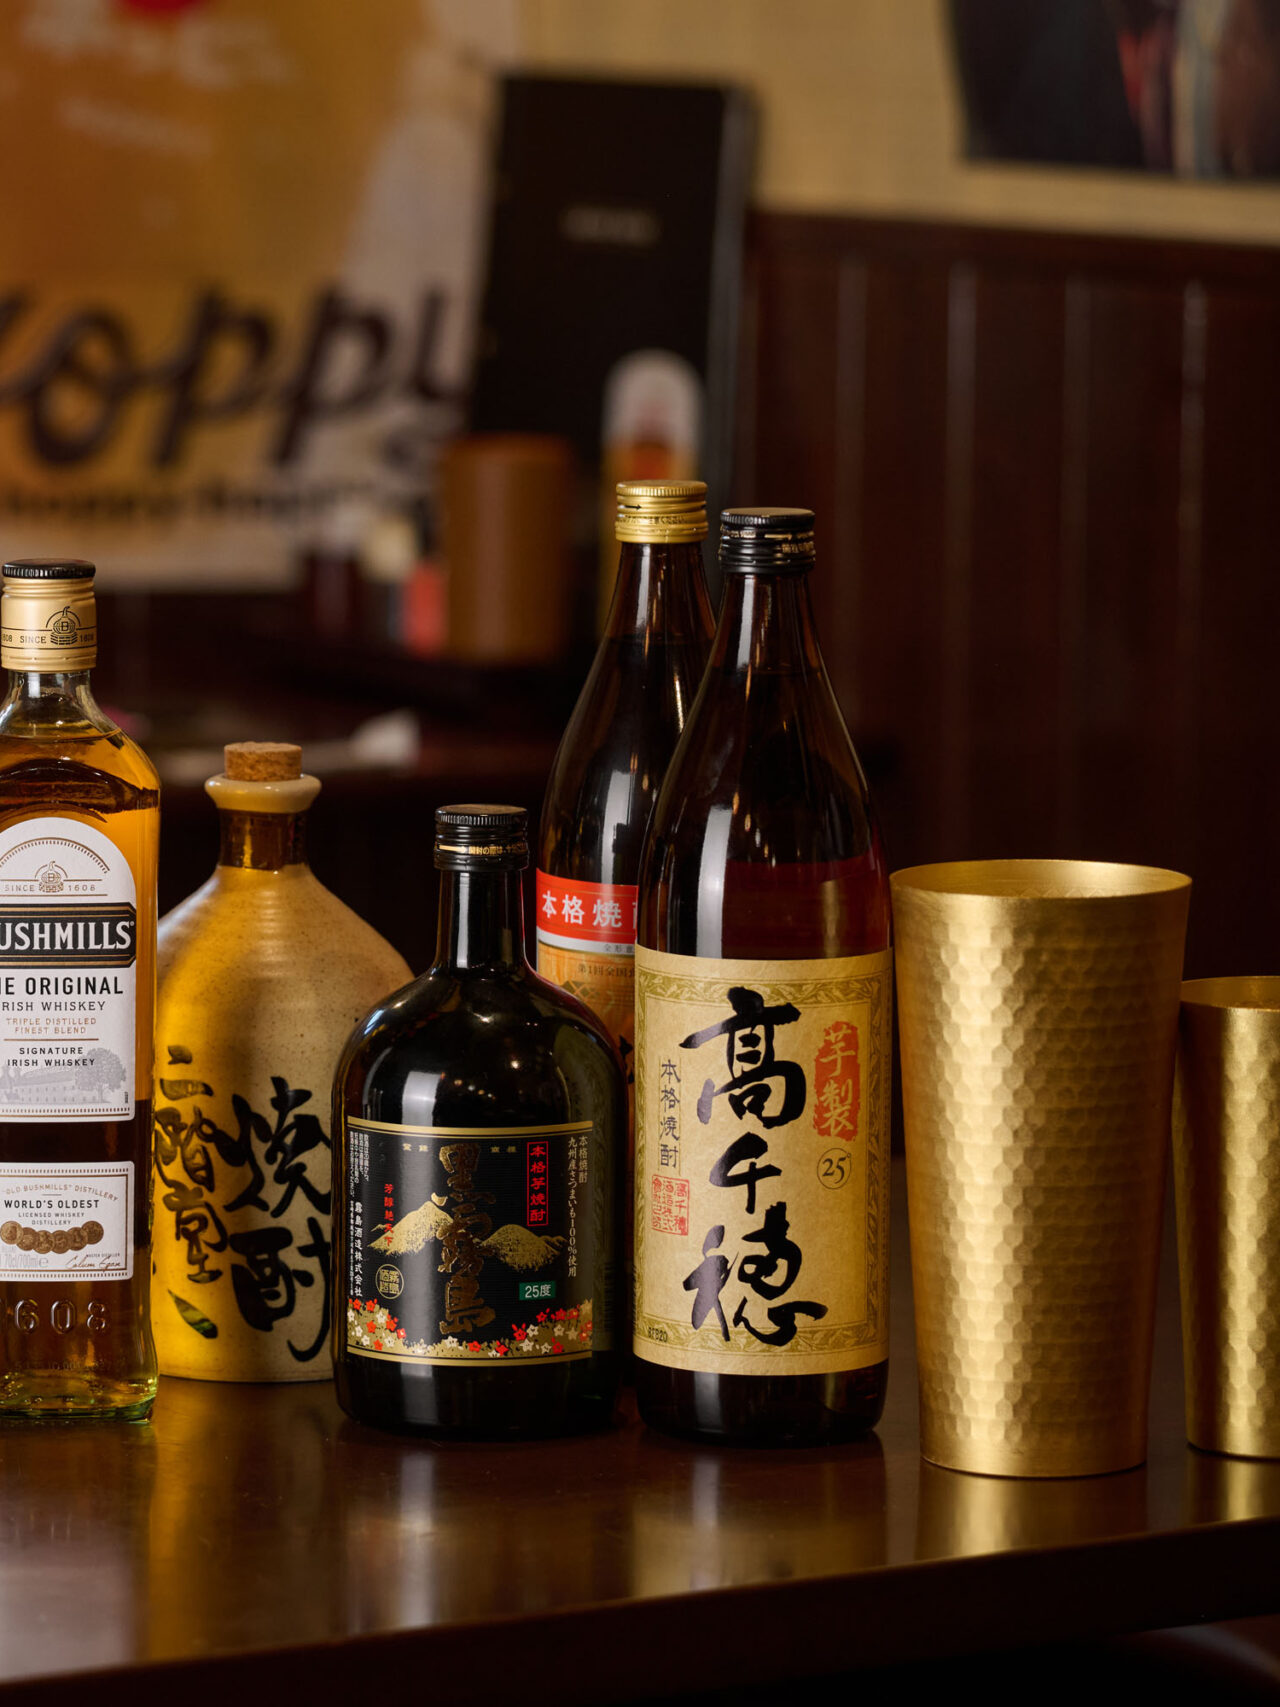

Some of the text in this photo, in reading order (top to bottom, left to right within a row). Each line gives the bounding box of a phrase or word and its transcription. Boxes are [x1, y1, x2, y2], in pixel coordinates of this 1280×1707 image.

[20, 635, 47, 644] SINCE
[4, 884, 35, 892] SINCE
[542, 889, 637, 929] 本格焼
[25, 976, 124, 995] ORIGINAL
[41, 1001, 106, 1011] WHISKEY
[45, 1017, 97, 1025] DISTILLED
[19, 1047, 84, 1055] SIGNATURE
[7, 1058, 95, 1067] IRISH WHISKEY
[529, 1144, 546, 1222] 本格芋焼酎
[74, 1185, 119, 1202] DISTILLERY
[4, 1200, 100, 1209] WORLD'S OLDEST
[525, 1284, 552, 1299] 25度
